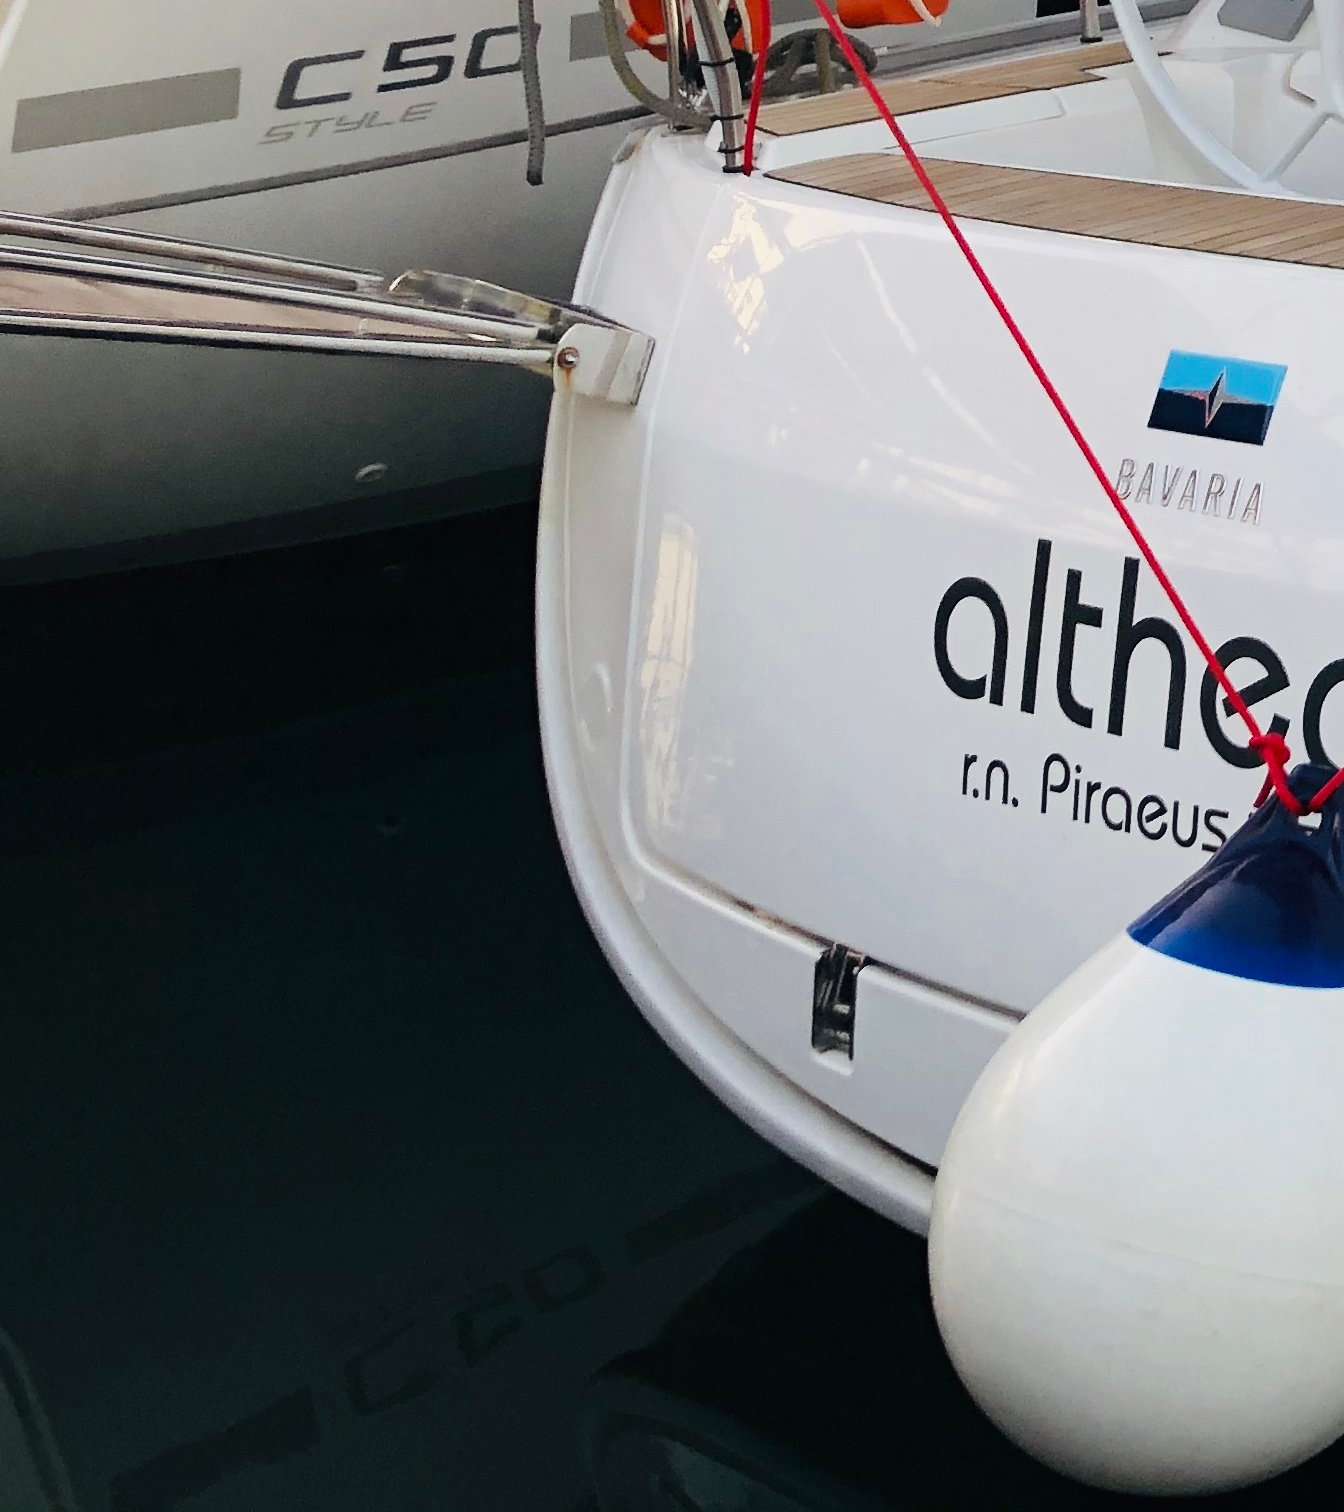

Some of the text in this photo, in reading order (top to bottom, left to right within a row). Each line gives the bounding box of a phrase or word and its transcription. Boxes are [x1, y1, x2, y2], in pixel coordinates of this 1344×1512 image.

[257, 100, 437, 145] STYLE
[1114, 457, 1266, 526] BAVARIA
[961, 752, 1230, 853] r.n. Piraeus
